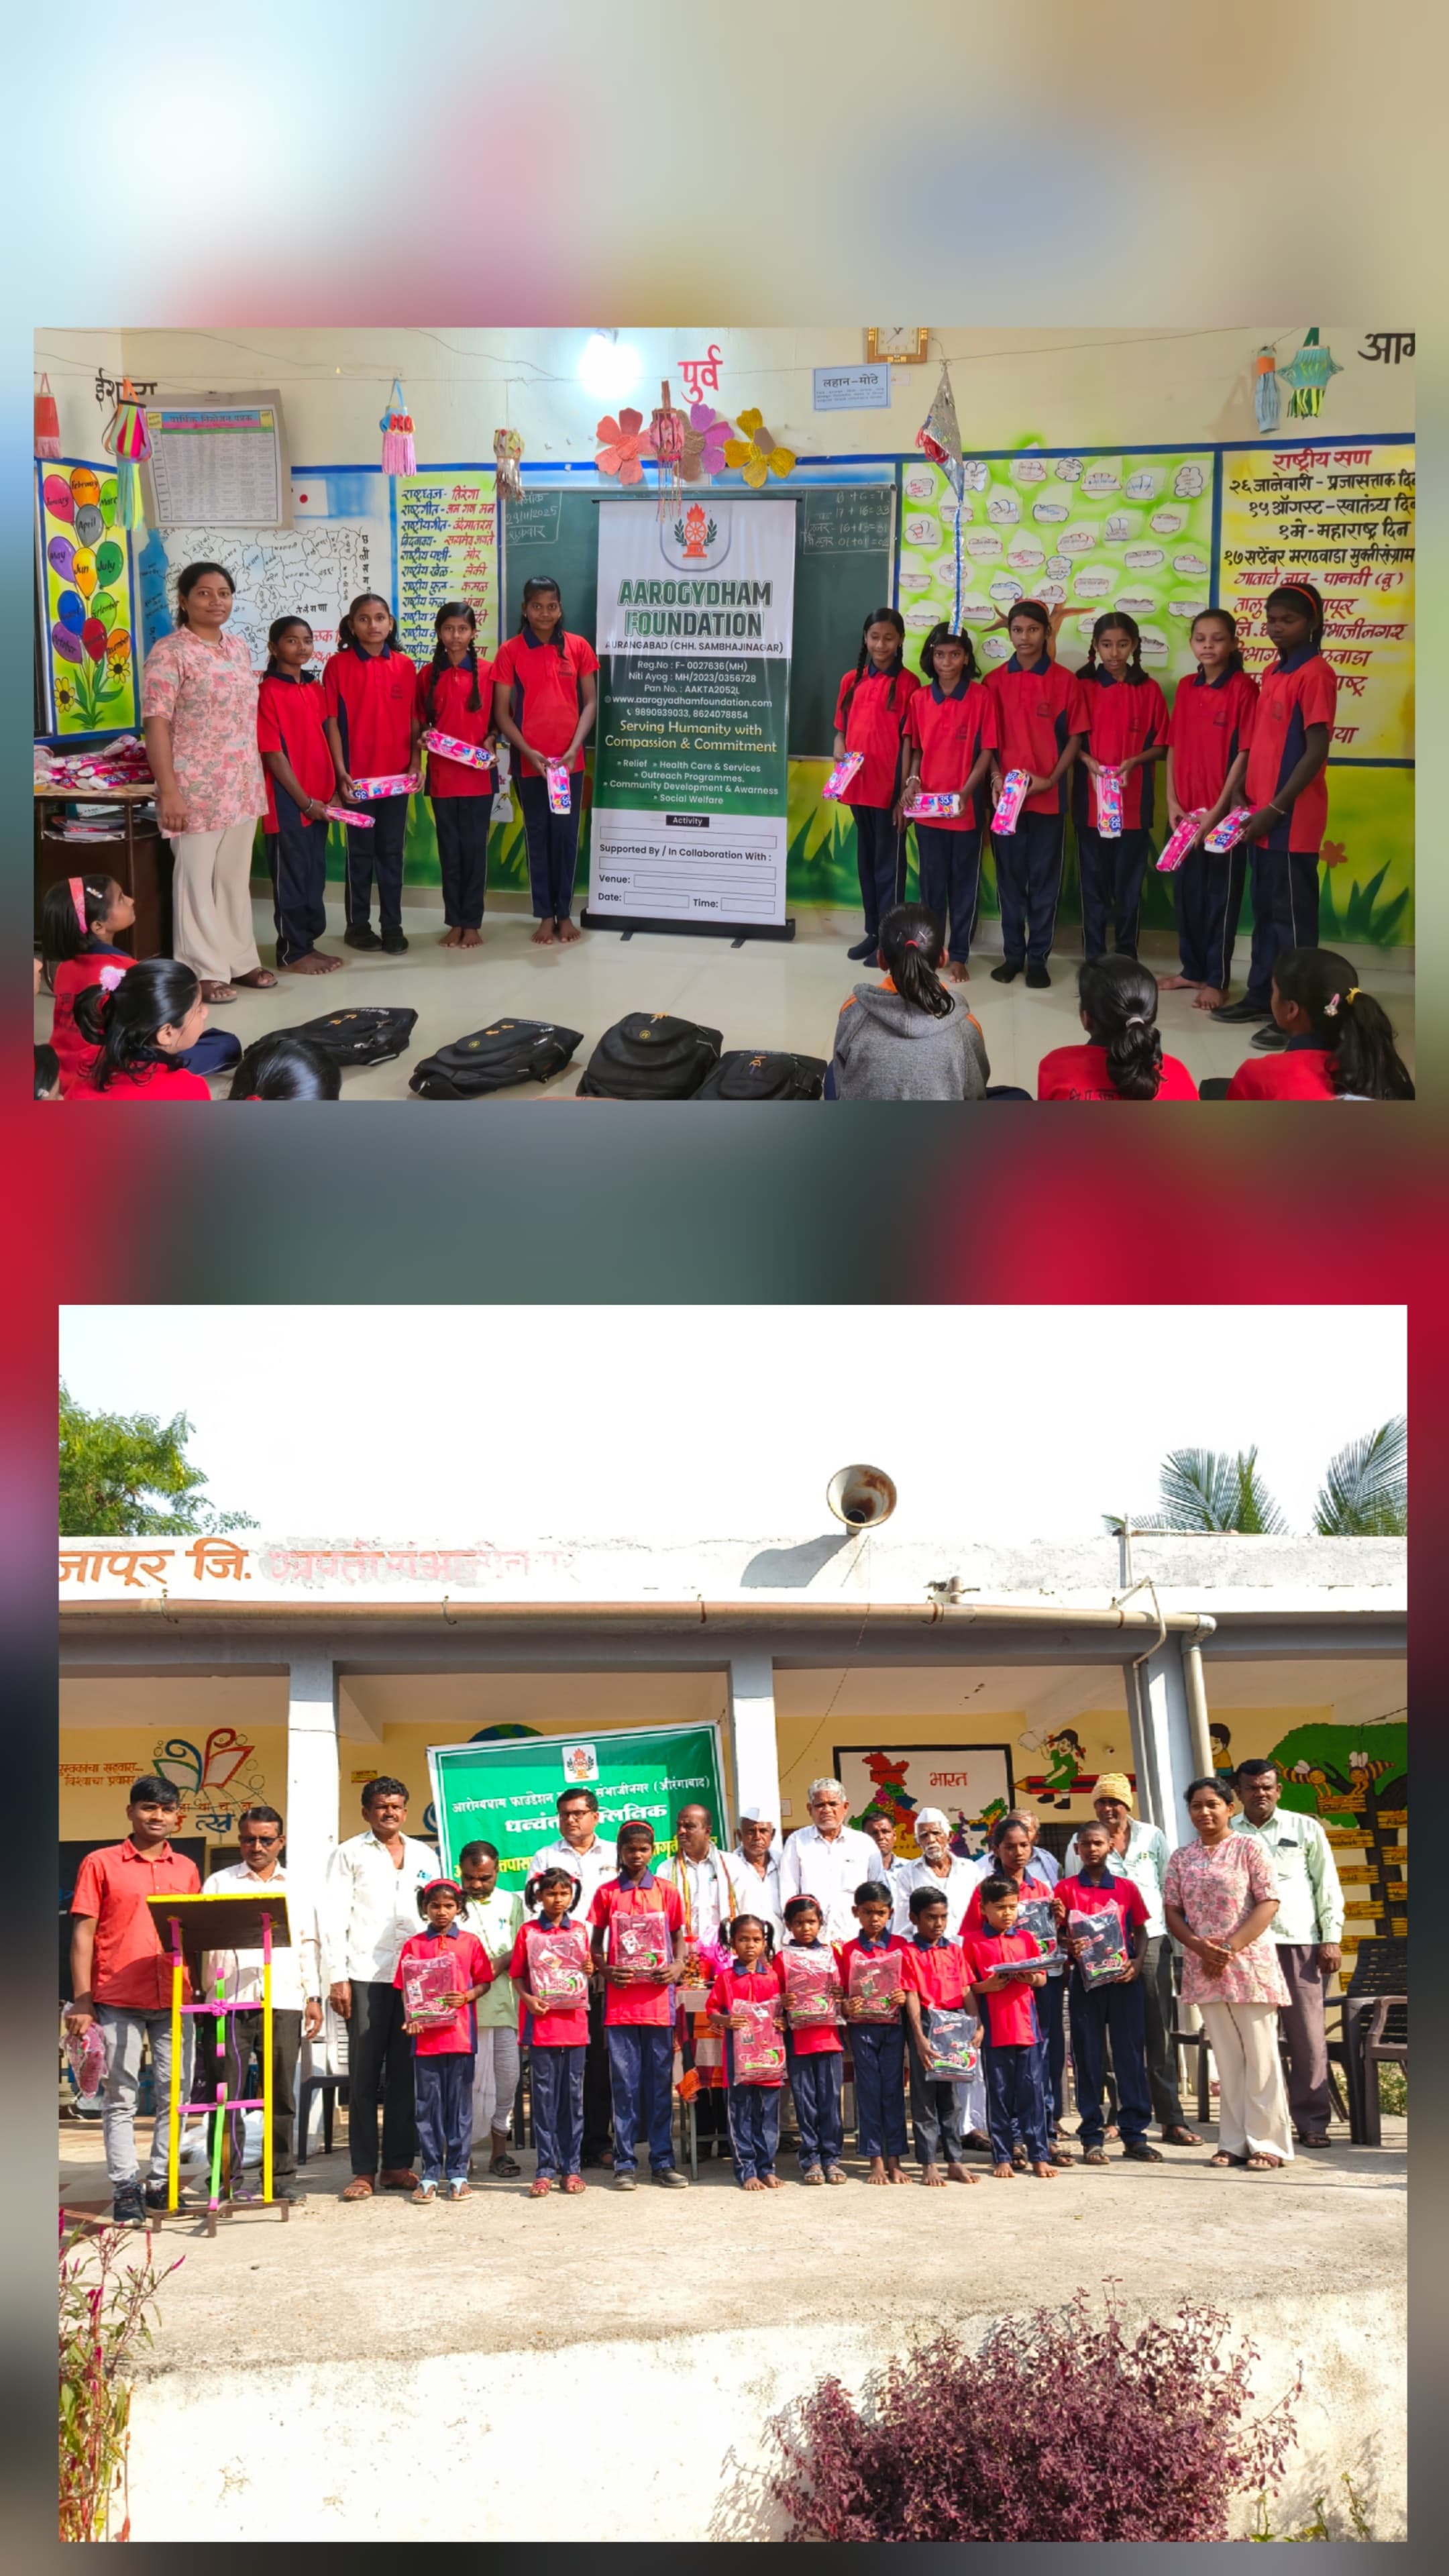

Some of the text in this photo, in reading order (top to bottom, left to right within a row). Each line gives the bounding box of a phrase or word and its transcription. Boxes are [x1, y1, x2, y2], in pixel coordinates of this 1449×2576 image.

[678, 344, 723, 404] पुर्व
[1273, 447, 1373, 472] राष्ट्रीय सण
[1328, 473, 1395, 490] प्रजासत्ताक
[78, 517, 96, 532] April
[1317, 522, 1379, 541] महाराष्ट्र
[1383, 516, 1411, 540] दिन
[50, 551, 66, 563] May
[1289, 548, 1348, 566] मराठवाडा
[74, 564, 89, 575] Jun
[97, 559, 115, 573] July
[618, 580, 772, 607] AAROGYDHAM
[625, 610, 764, 638] FOUNDATION
[605, 641, 783, 653] AURANGABAD (CHH. SAMBHAJINAGAR)
[687, 661, 747, 672] 0027636(MH)
[629, 672, 756, 683] Niti Ayog MH/2023/0356728
[645, 684, 661, 692] Pan
[663, 685, 678, 693] No.
[612, 696, 772, 708] www.aarogyadhamfoundation.com
[635, 708, 748, 719] 9890939033, 8624078854
[620, 720, 762, 737] Serving Humanity with
[605, 735, 777, 752] Compassion & Commitment
[623, 759, 761, 772] Relief Health Care & Services
[641, 771, 745, 783] Outreach Programmes.
[610, 780, 661, 792] Community
[663, 783, 722, 794] Development
[735, 786, 778, 795] Awarness
[660, 794, 723, 804] Social Welfare
[673, 817, 702, 826] Activity
[600, 844, 646, 855] Supported
[649, 847, 659, 856] By
[680, 848, 743, 859] Collaboration
[745, 852, 766, 861] With
[599, 875, 630, 883] Venue:
[598, 893, 718, 908] Date: Time:
[185, 1538, 252, 1580] जि.
[929, 1771, 968, 1787] भारत
